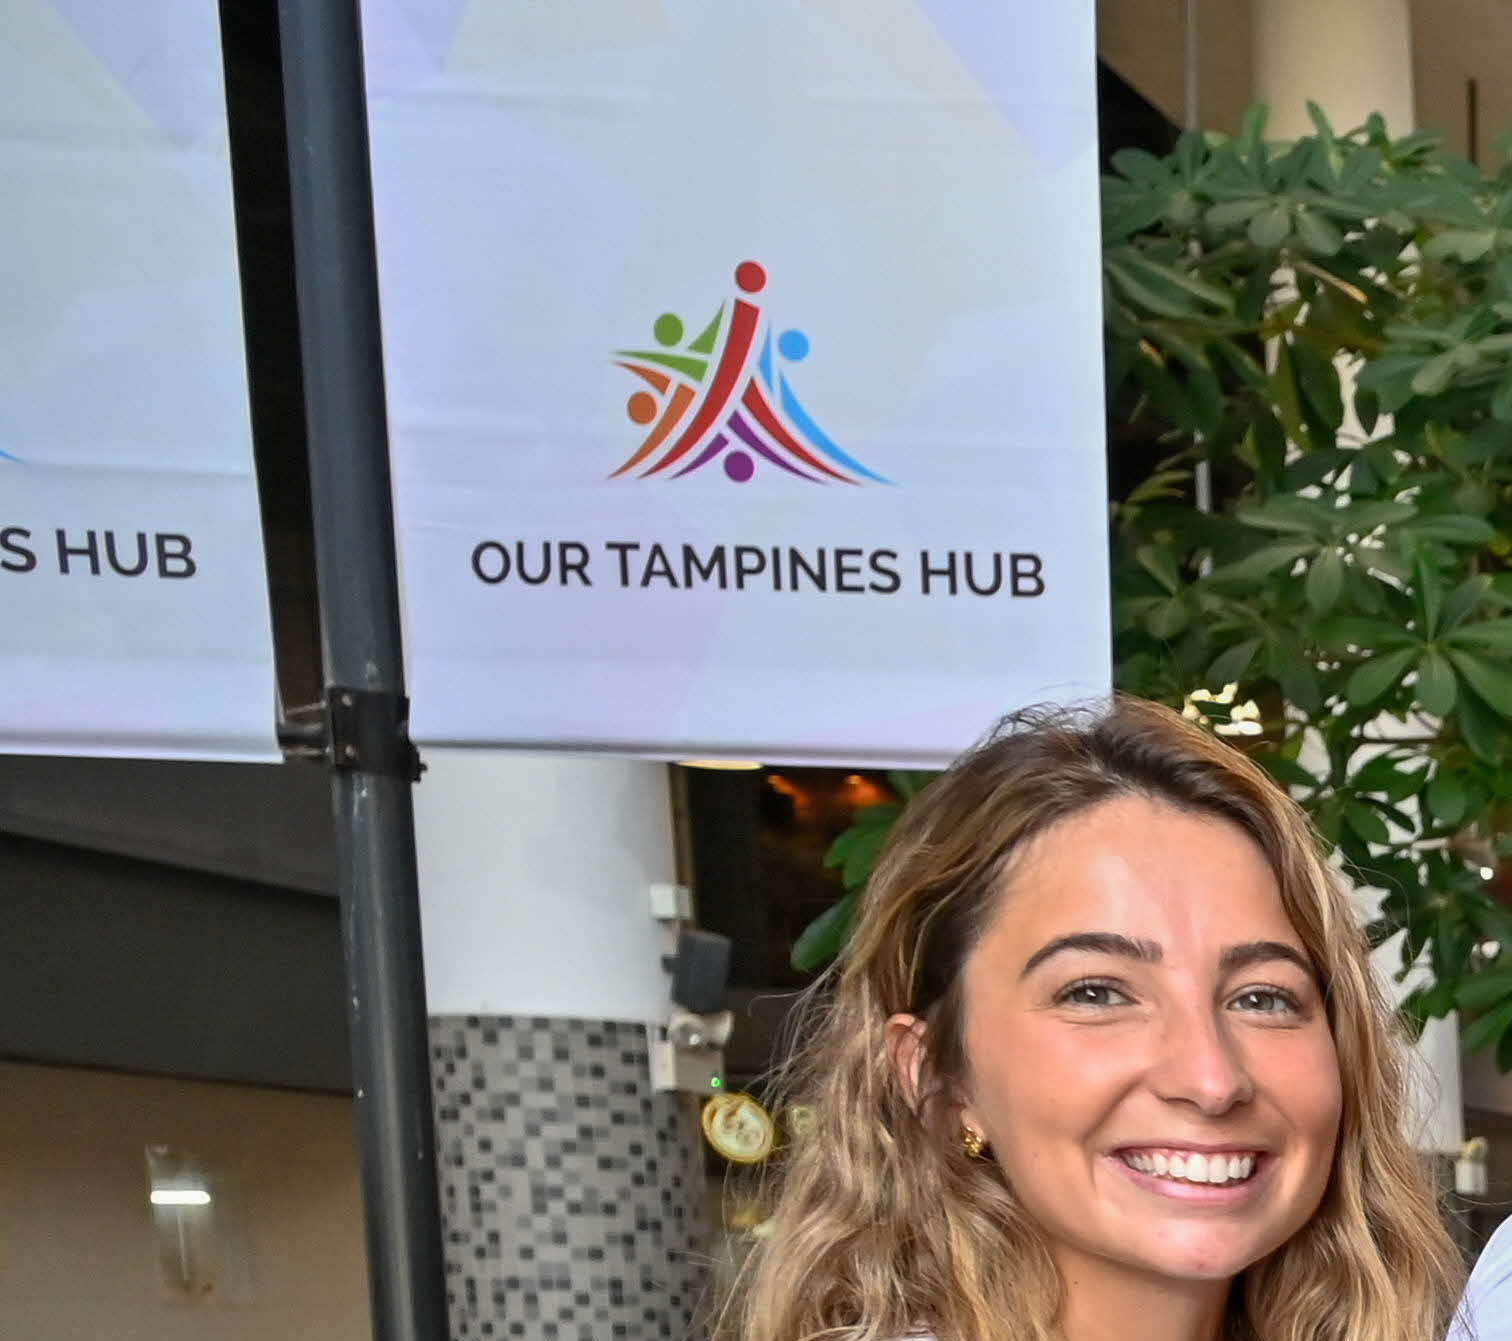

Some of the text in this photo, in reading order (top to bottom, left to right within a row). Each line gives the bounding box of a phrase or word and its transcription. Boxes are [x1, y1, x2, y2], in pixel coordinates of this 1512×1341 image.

[58, 530, 198, 580] HUB
[470, 539, 1048, 599] OUR TAMPINES HUB
